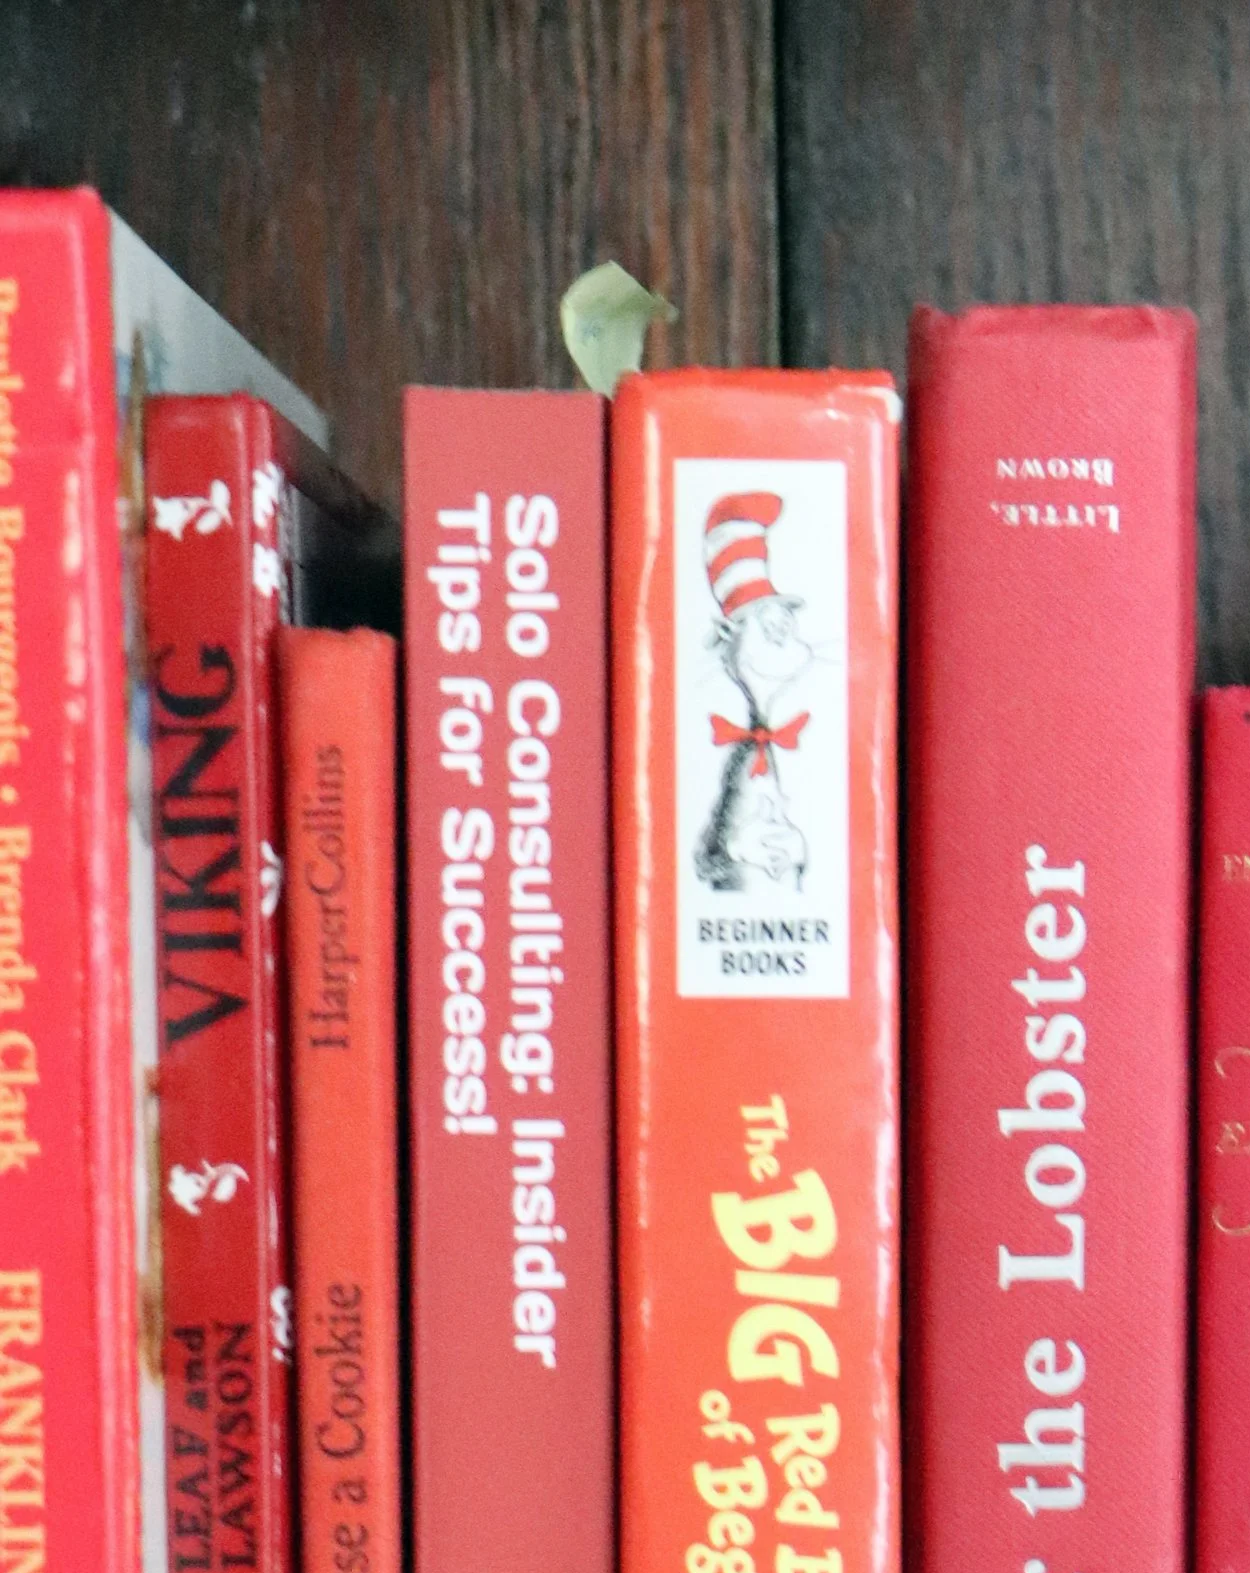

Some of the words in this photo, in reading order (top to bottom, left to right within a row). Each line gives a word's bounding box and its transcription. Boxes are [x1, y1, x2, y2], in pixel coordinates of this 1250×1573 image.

[991, 504, 1120, 533] LITTLE,
[998, 458, 1114, 486] BROWN
[427, 492, 491, 653] Tips
[505, 495, 559, 657] Solo
[439, 677, 493, 786] for
[0, 826, 37, 1012] Brenda
[157, 644, 248, 1048] VIKING
[302, 744, 358, 1051] HarperCollins
[500, 680, 564, 1093] Consulting:
[441, 808, 497, 1134] Success!
[699, 919, 828, 943] BEGINNER
[721, 950, 806, 975] BOOKS
[0, 1030, 40, 1173] Clark
[741, 1095, 789, 1172] The
[998, 844, 1086, 1290] Lobster
[512, 1119, 566, 1368] Insider
[712, 1164, 840, 1386] BIG
[170, 1325, 208, 1411] and
[213, 1322, 257, 1568] LAWSON
[310, 1284, 366, 1461] Cookie
[699, 1390, 755, 1444] of
[997, 1338, 1086, 1516] the
[170, 1426, 212, 1573] LEAF
[332, 1477, 368, 1505] a
[760, 1403, 840, 1528] Red
